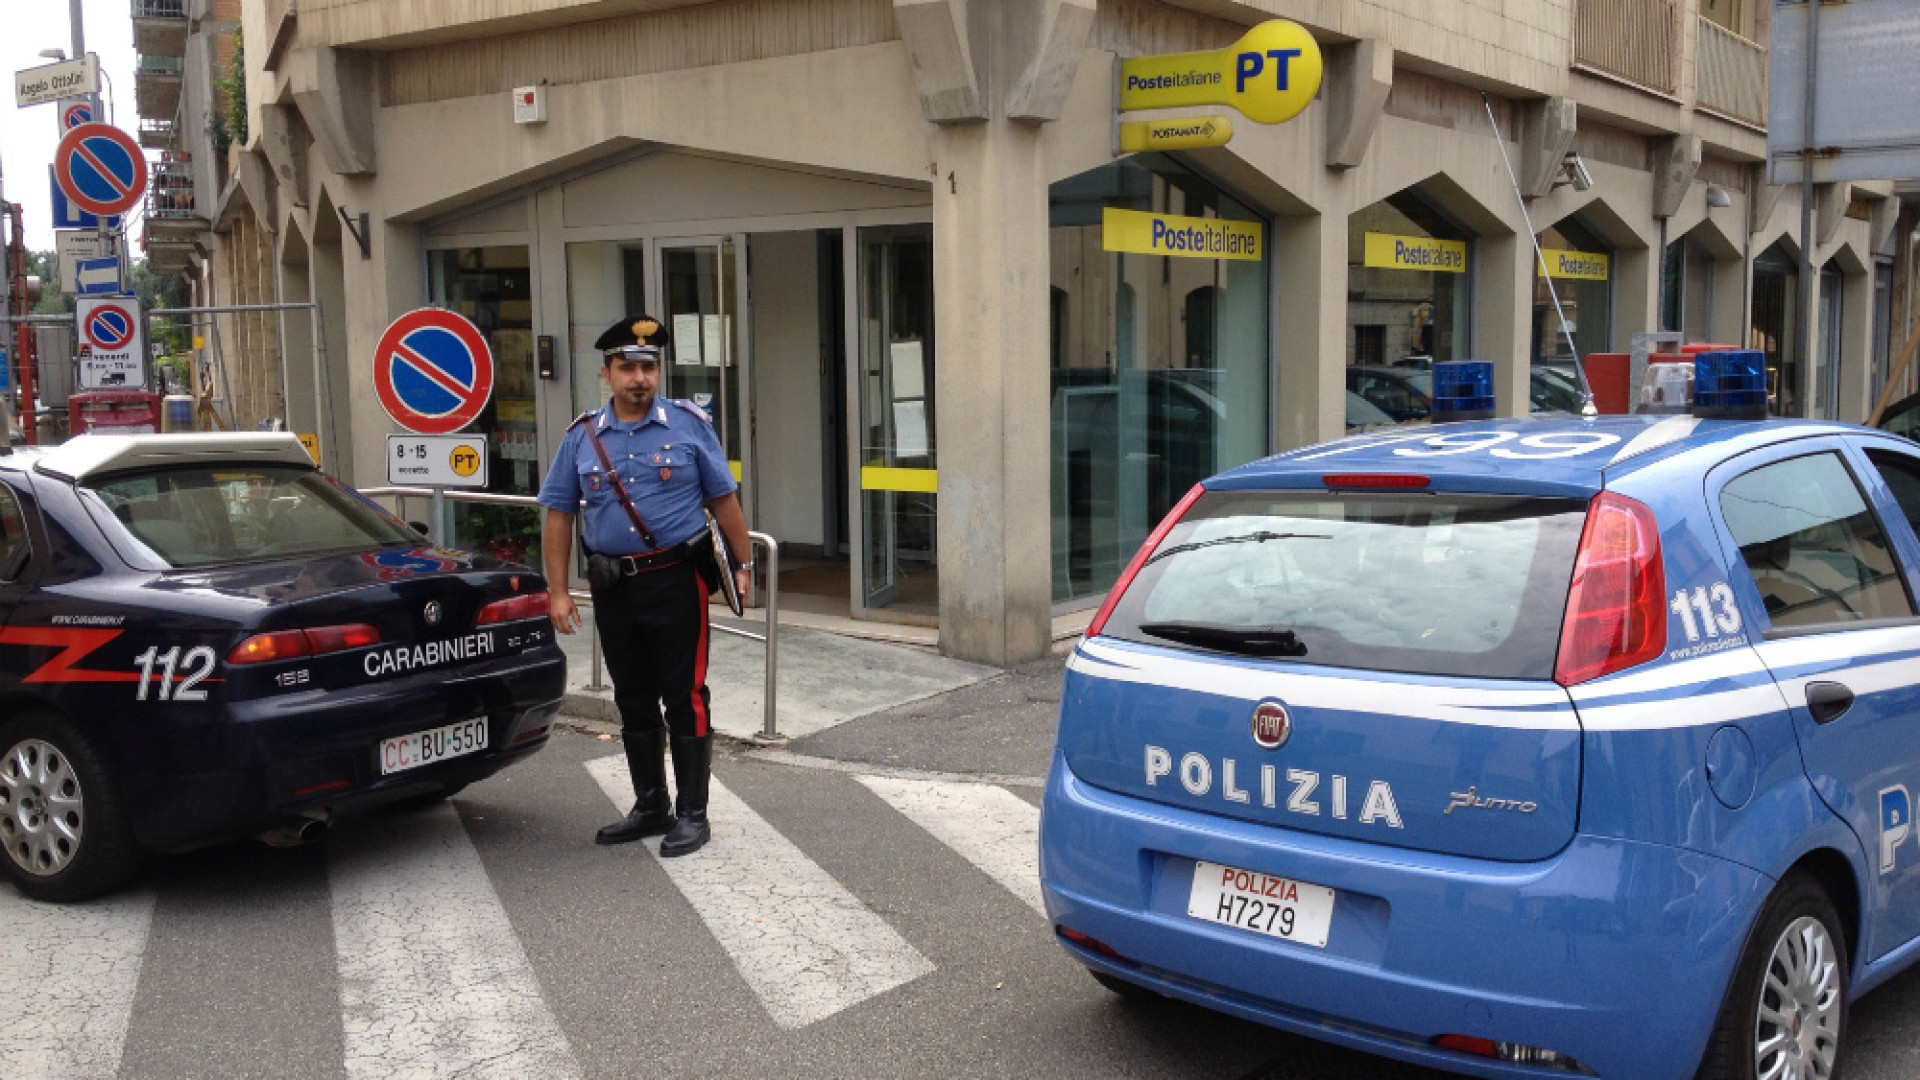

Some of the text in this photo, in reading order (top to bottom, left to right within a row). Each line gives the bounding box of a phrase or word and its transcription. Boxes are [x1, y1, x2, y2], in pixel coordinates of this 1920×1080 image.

[1127, 70, 1222, 91] Posteitaliane
[1236, 48, 1302, 93] PT
[1152, 126, 1201, 139] POSTAMAT
[1152, 218, 1255, 255] Posteitaliane
[1395, 239, 1462, 267] Posteitaliane
[1558, 254, 1605, 276] Posteitaliane
[396, 444, 404, 459] 8
[415, 444, 427, 459] 15
[454, 453, 475, 470] PT
[1669, 581, 1741, 643] 113
[364, 631, 495, 677] CARABINIERI
[134, 645, 216, 701] 112
[1260, 714, 1282, 738] FIAT
[385, 721, 485, 770] CC BU 550
[1144, 744, 1403, 830] POLIZIA
[1221, 867, 1299, 903] POLIZIA
[1216, 893, 1296, 937] H7279
